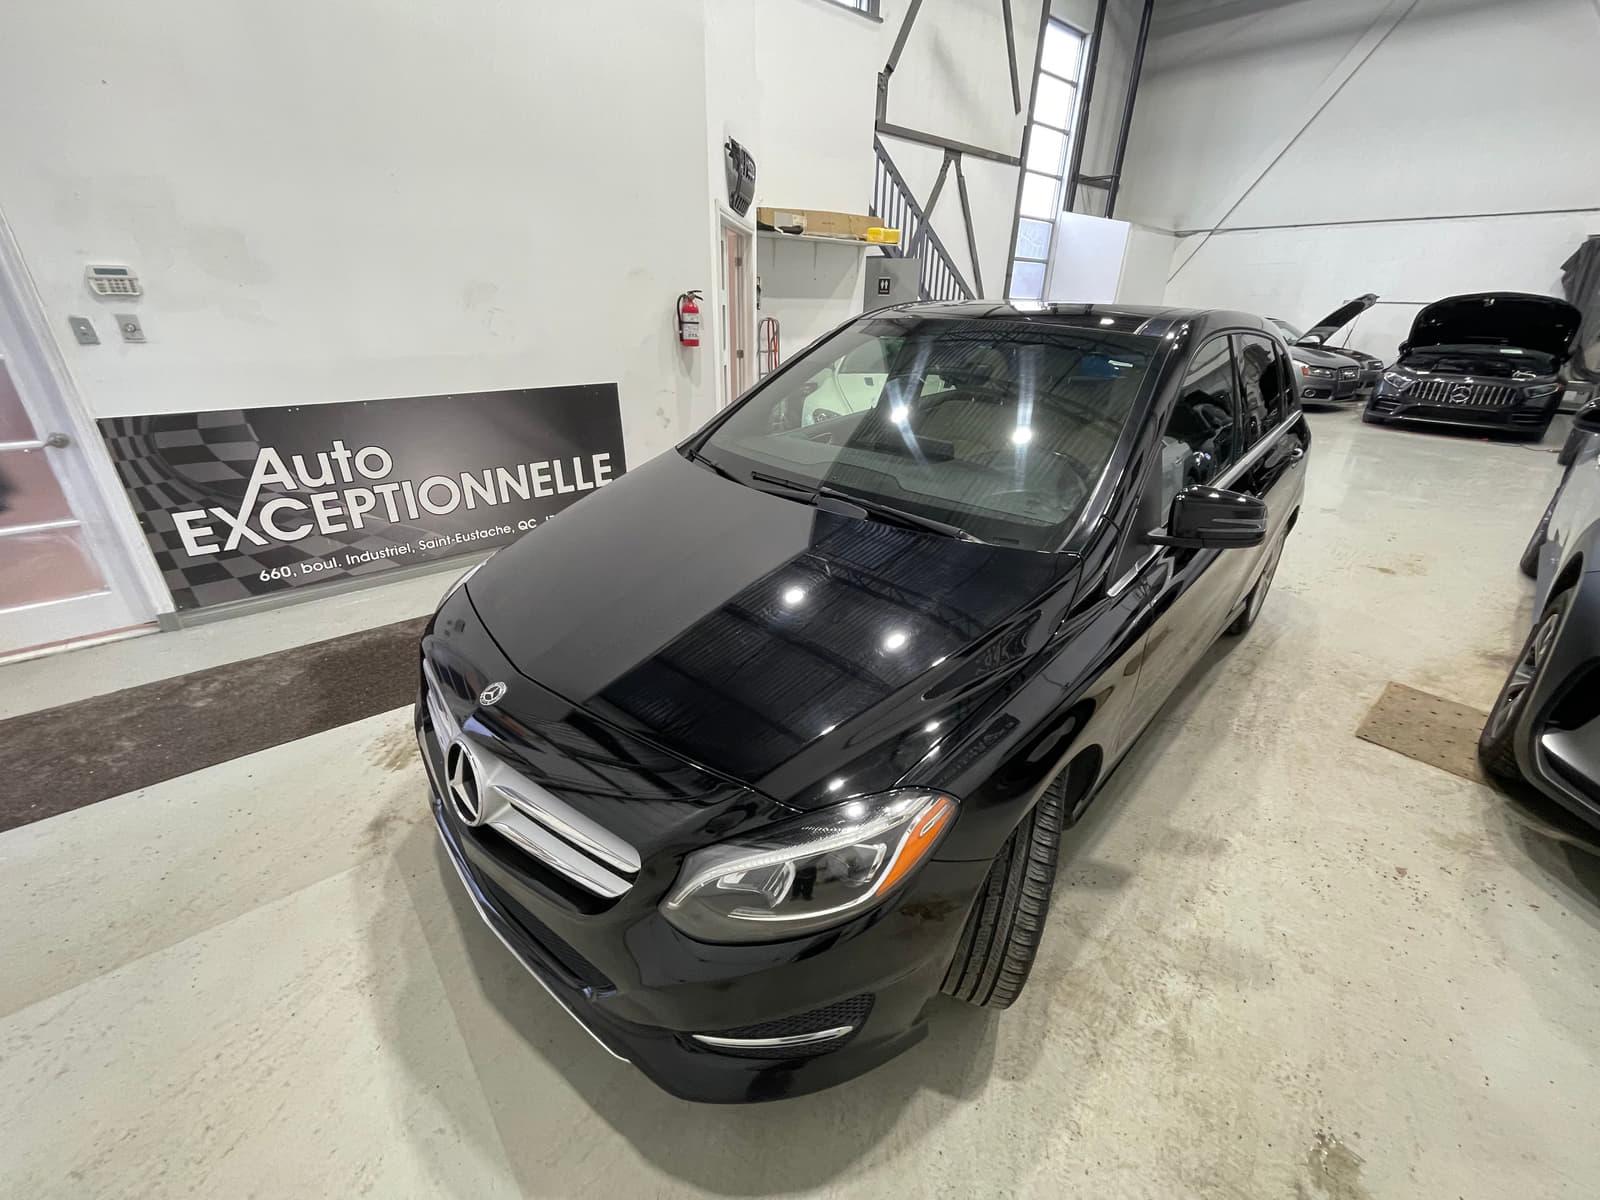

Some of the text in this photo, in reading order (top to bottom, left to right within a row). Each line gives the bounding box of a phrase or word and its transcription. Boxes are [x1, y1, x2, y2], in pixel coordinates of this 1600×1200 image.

[247, 440, 393, 491] Auto
[171, 452, 614, 557] EXCEPTIONNELLE
[259, 518, 537, 582] 660, boul. Industriel, Saint-Eustache, QC
